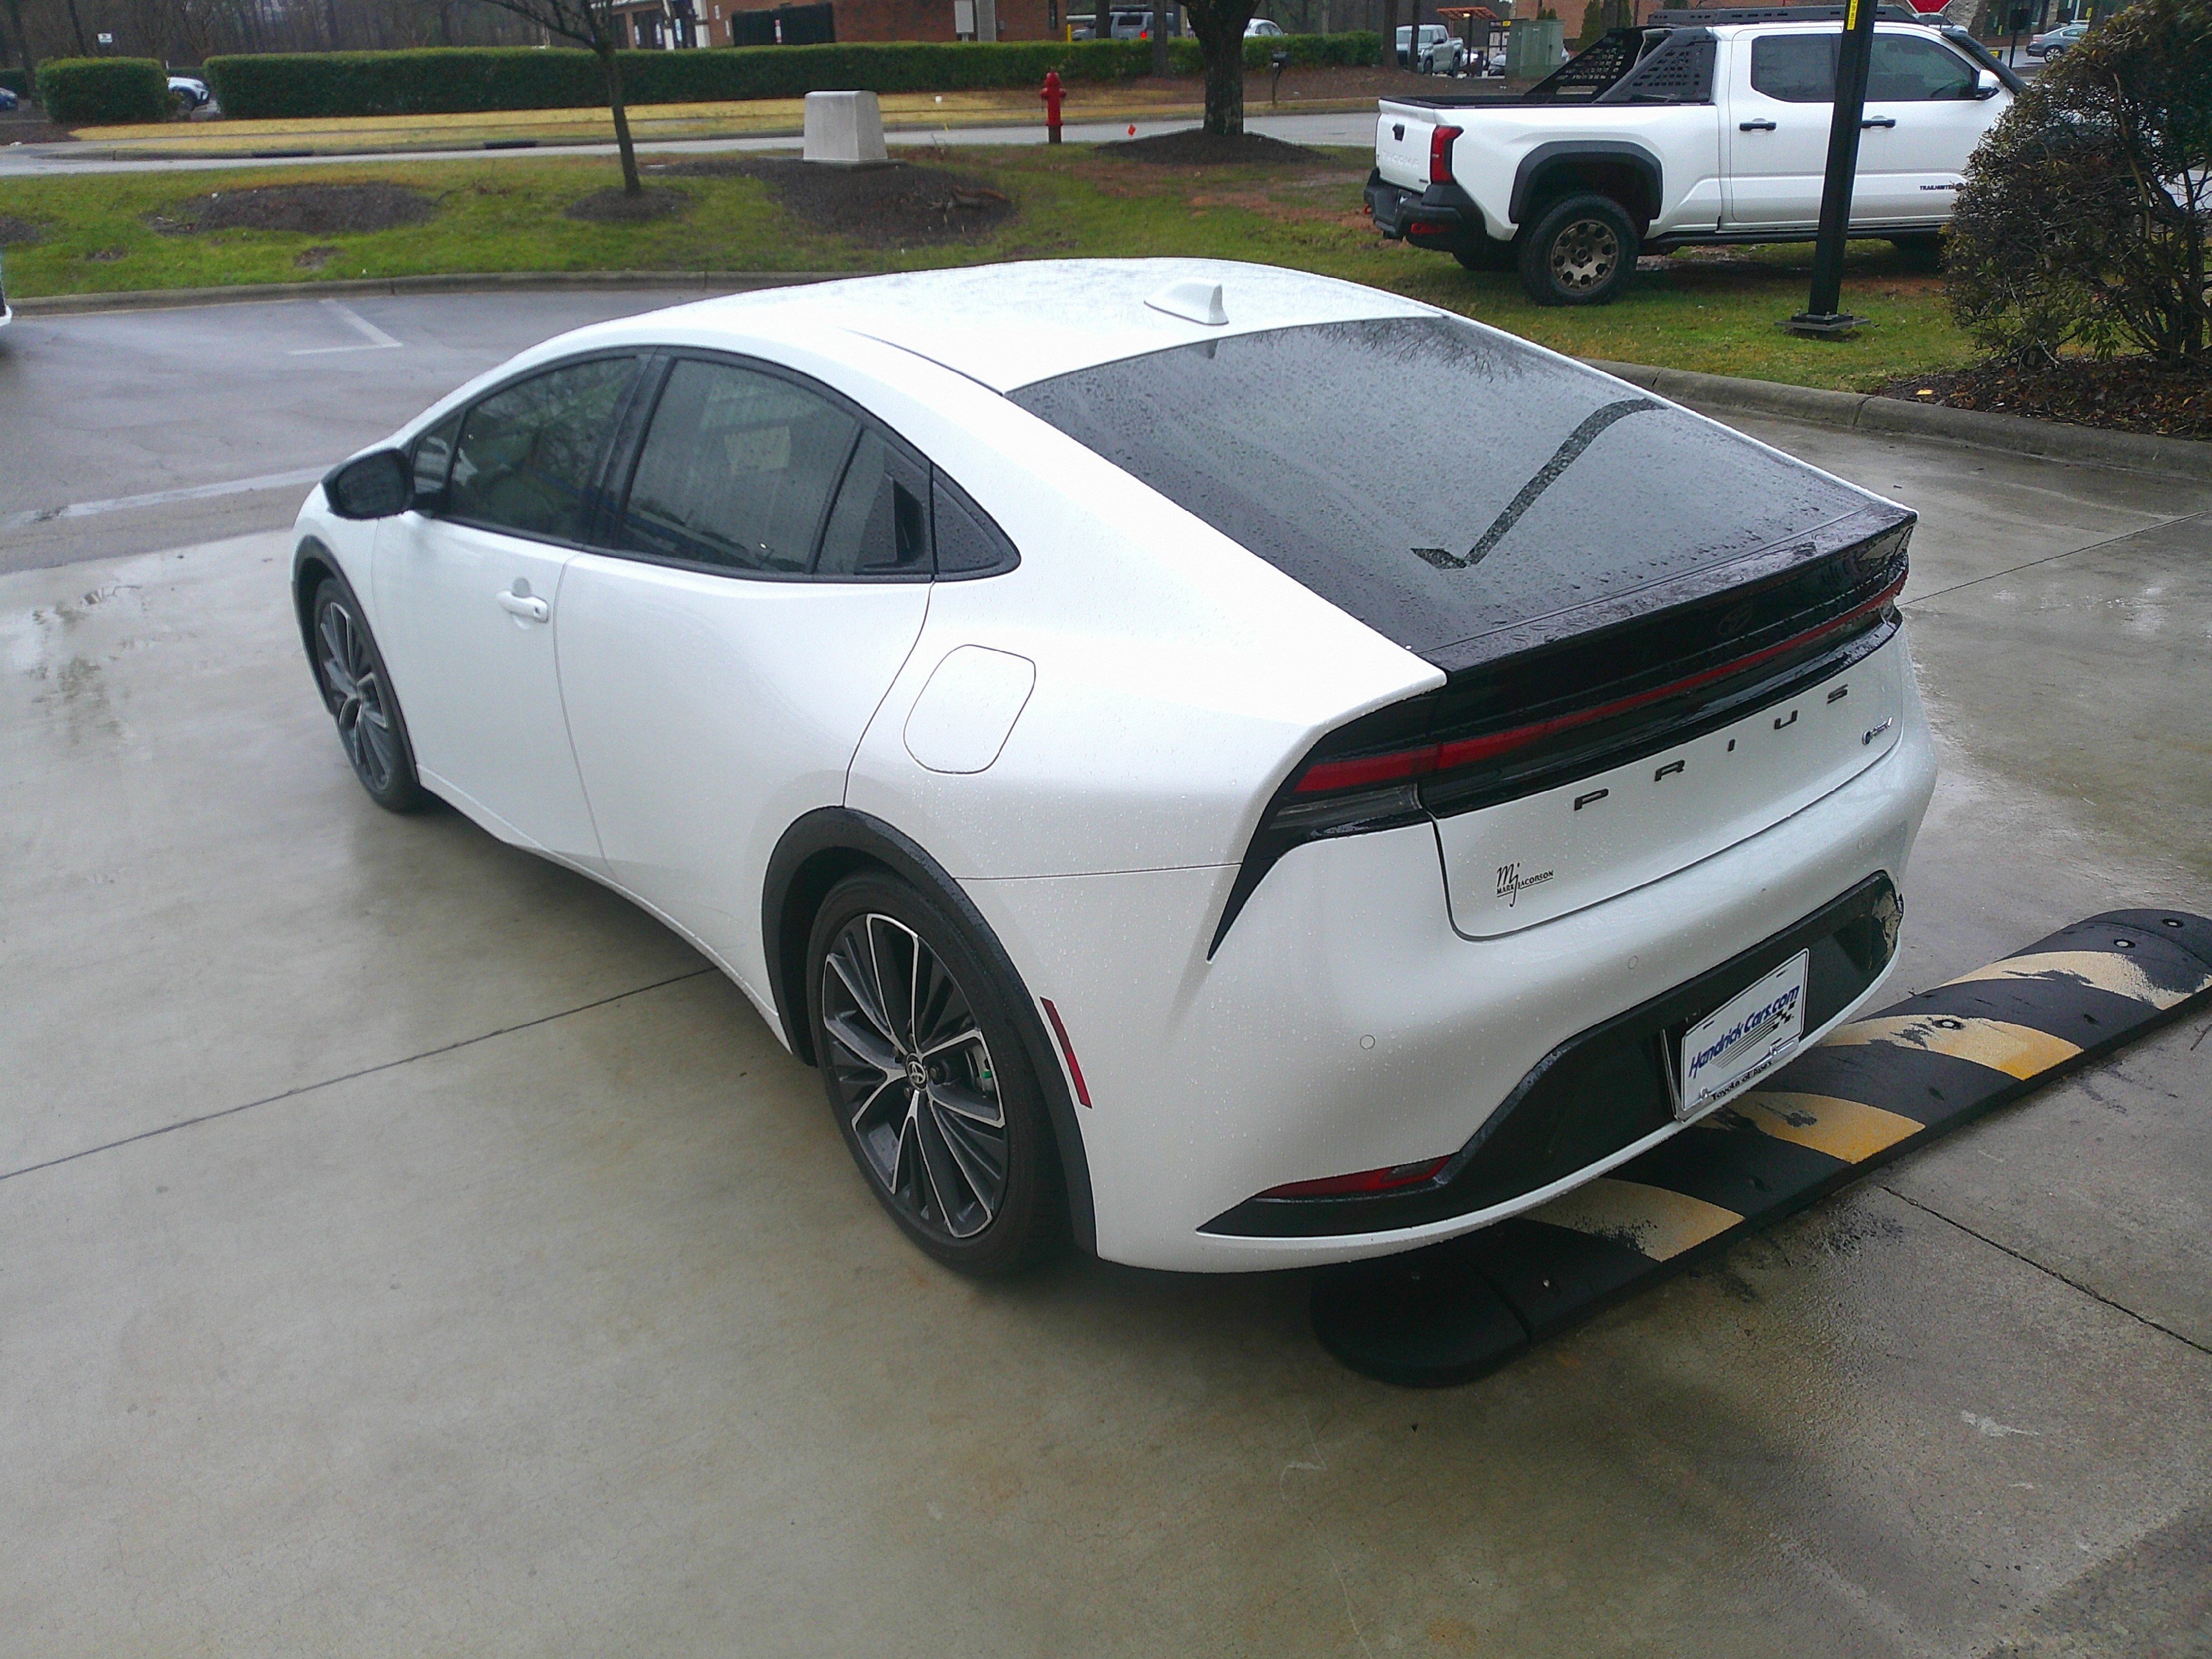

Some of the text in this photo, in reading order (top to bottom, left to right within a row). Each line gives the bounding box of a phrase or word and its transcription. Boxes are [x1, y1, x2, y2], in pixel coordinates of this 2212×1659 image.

[1574, 684, 1849, 811] PRIUS
[1496, 870, 1553, 895] MARK JACOBSON
[1711, 1060, 1772, 1100] Toyota of Apex
